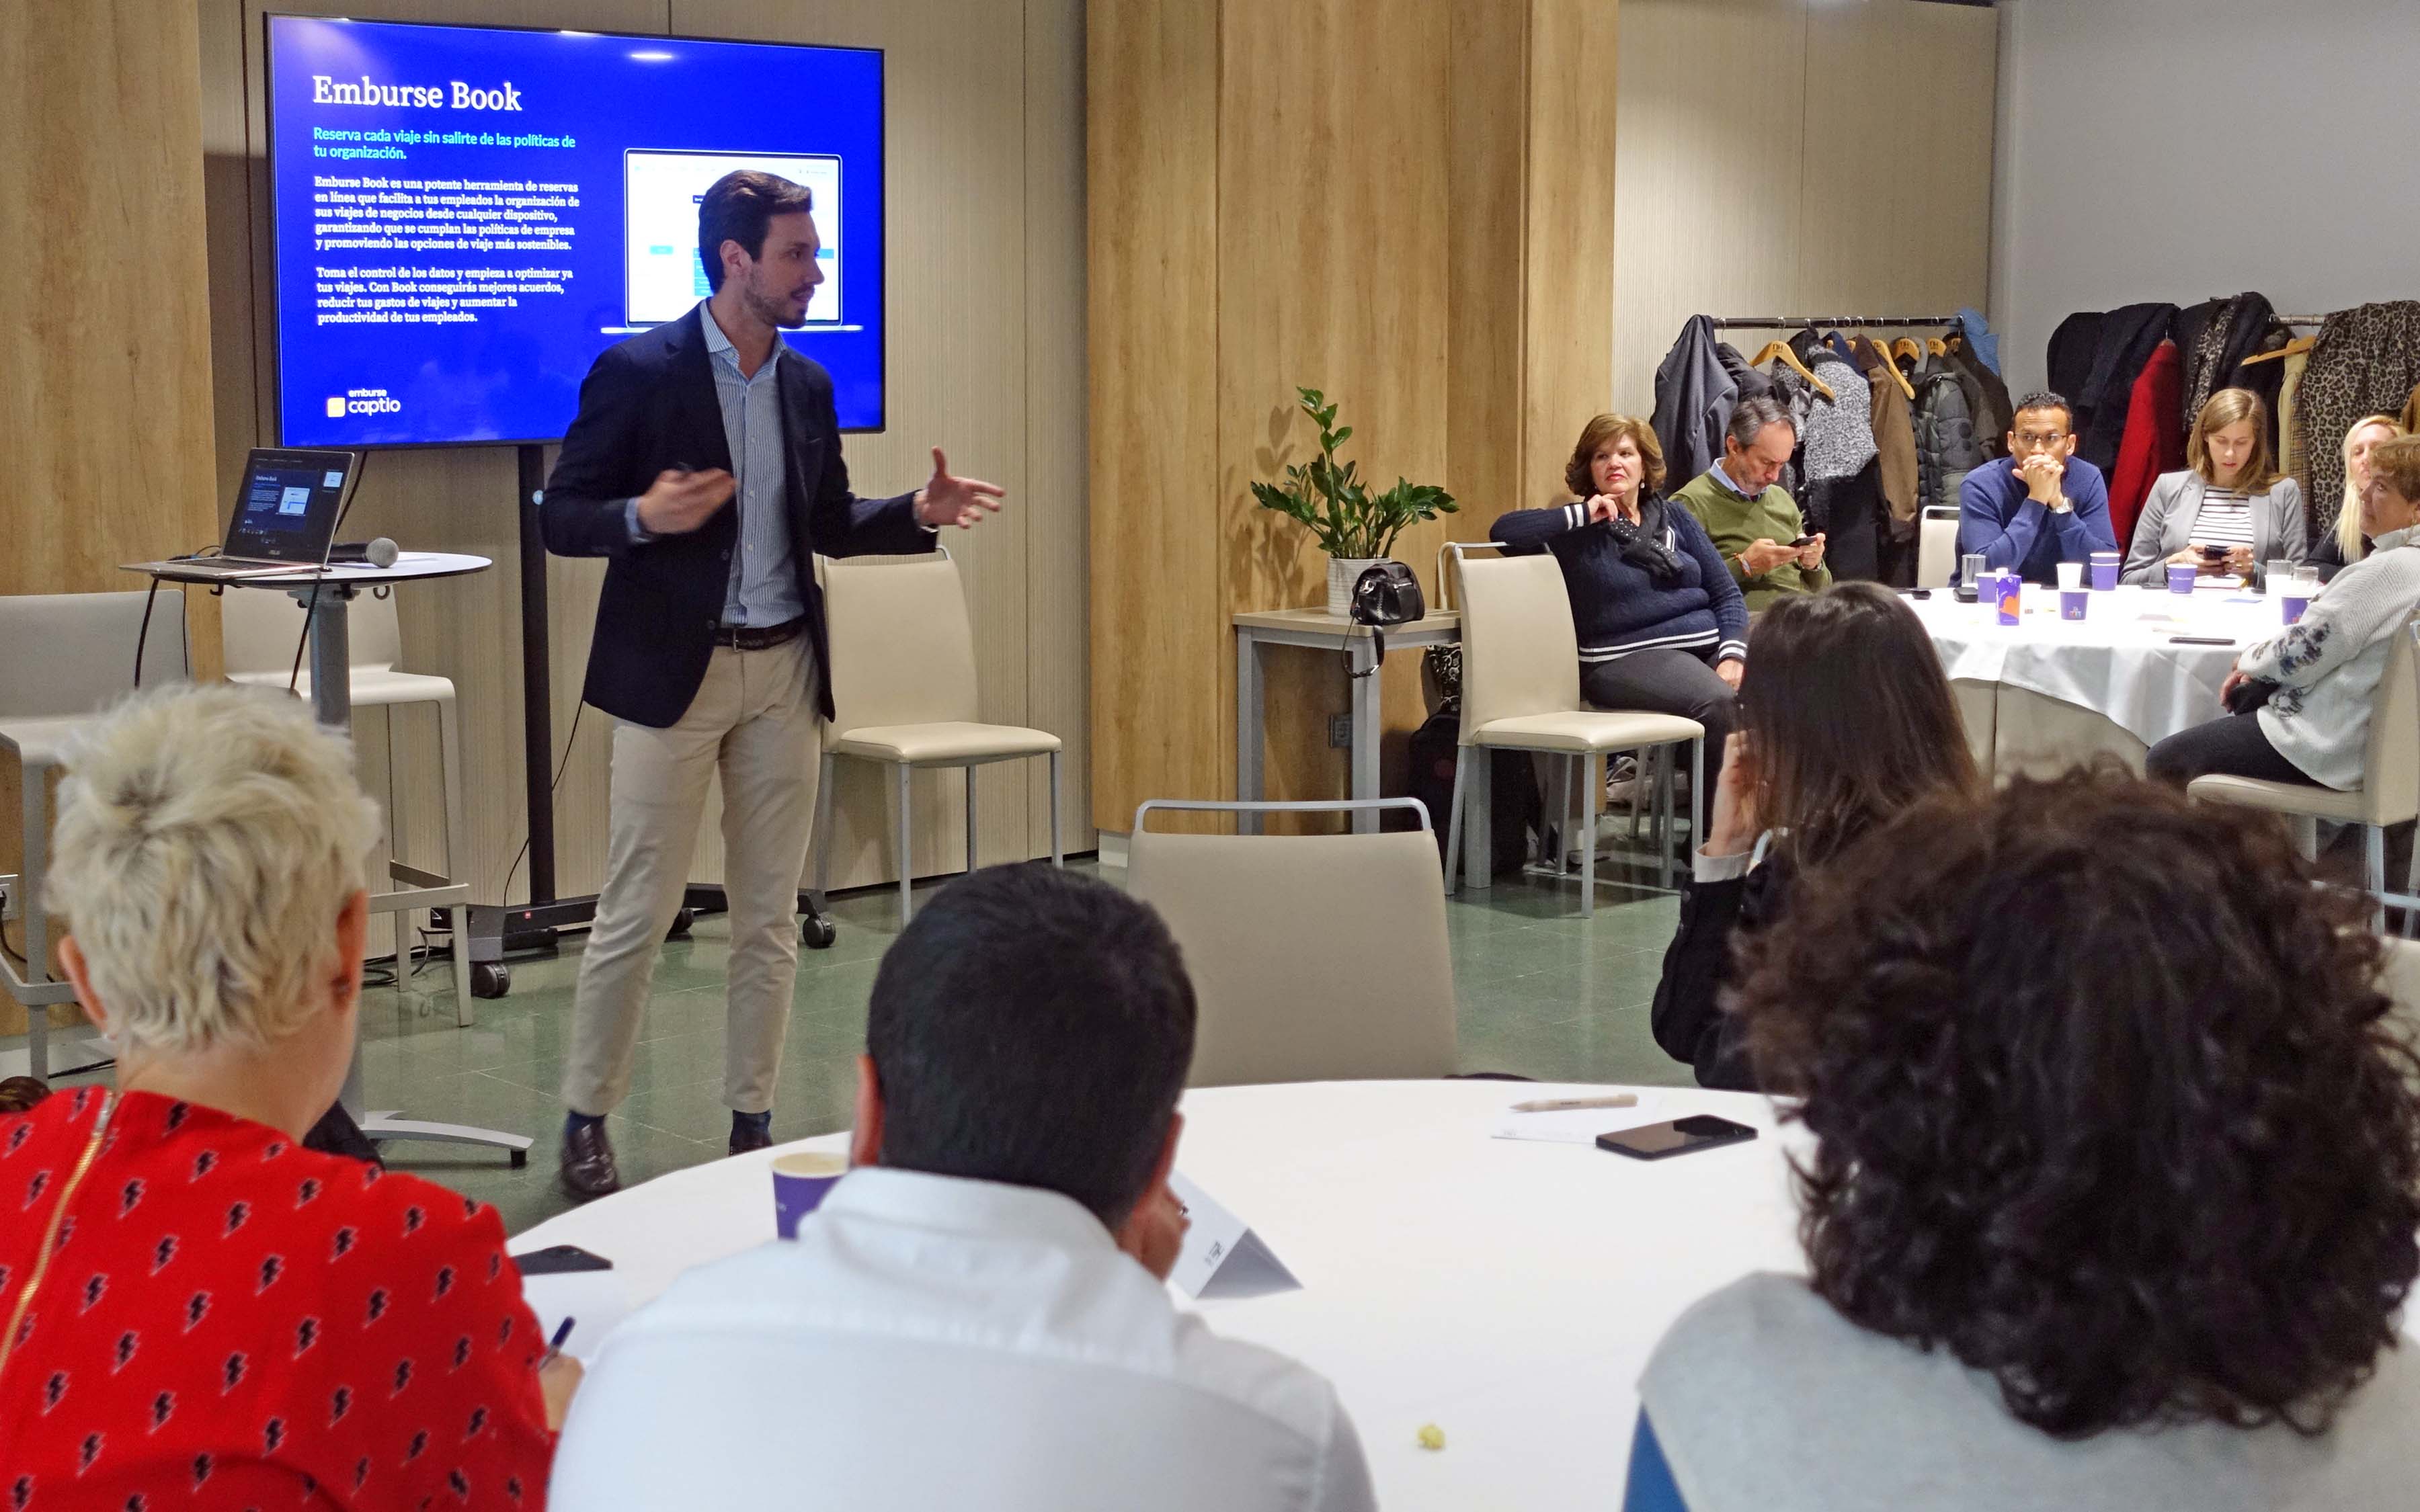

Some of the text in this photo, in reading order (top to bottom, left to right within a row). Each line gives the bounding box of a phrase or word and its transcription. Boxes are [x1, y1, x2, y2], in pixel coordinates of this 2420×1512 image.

[313, 75, 522, 110] Emburse Book
[314, 127, 575, 148] Reserva cada viaje sin salirte de las políticas de
[314, 145, 406, 160] tu organización.
[315, 177, 578, 192] Emburse Book es una potente herramienta de reservas
[315, 194, 328, 202] en
[330, 192, 356, 202] línea
[358, 195, 376, 206] que
[378, 193, 413, 204] facilita
[423, 195, 438, 204] tus
[440, 194, 493, 207] empleados
[495, 195, 504, 205] la
[506, 196, 566, 208] organización
[568, 196, 579, 206] de
[315, 207, 557, 222] sus viajes de negocios desde cualquier dispositivo,
[315, 222, 575, 237] garantizando que se cumplan las políticas de empresa
[316, 238, 571, 251] y promoviendo las opciones de viaje más sostenibles.
[316, 267, 346, 278] Toma
[348, 267, 358, 278] el
[360, 267, 397, 278] control
[398, 267, 411, 278] de
[412, 267, 427, 278] los
[429, 267, 455, 278] datos
[456, 270, 463, 280] y
[465, 267, 506, 280] empieza
[515, 267, 560, 280] optimizar
[561, 270, 573, 280] ya
[317, 282, 564, 295] tus viajes. Con Book conseguirás mejores acuerdos,
[317, 296, 517, 310] reducir tus gastos de viajes y aumentar la
[318, 311, 477, 325] productividad de tus empleados.
[348, 388, 387, 397] emburse
[348, 397, 401, 417] captio
